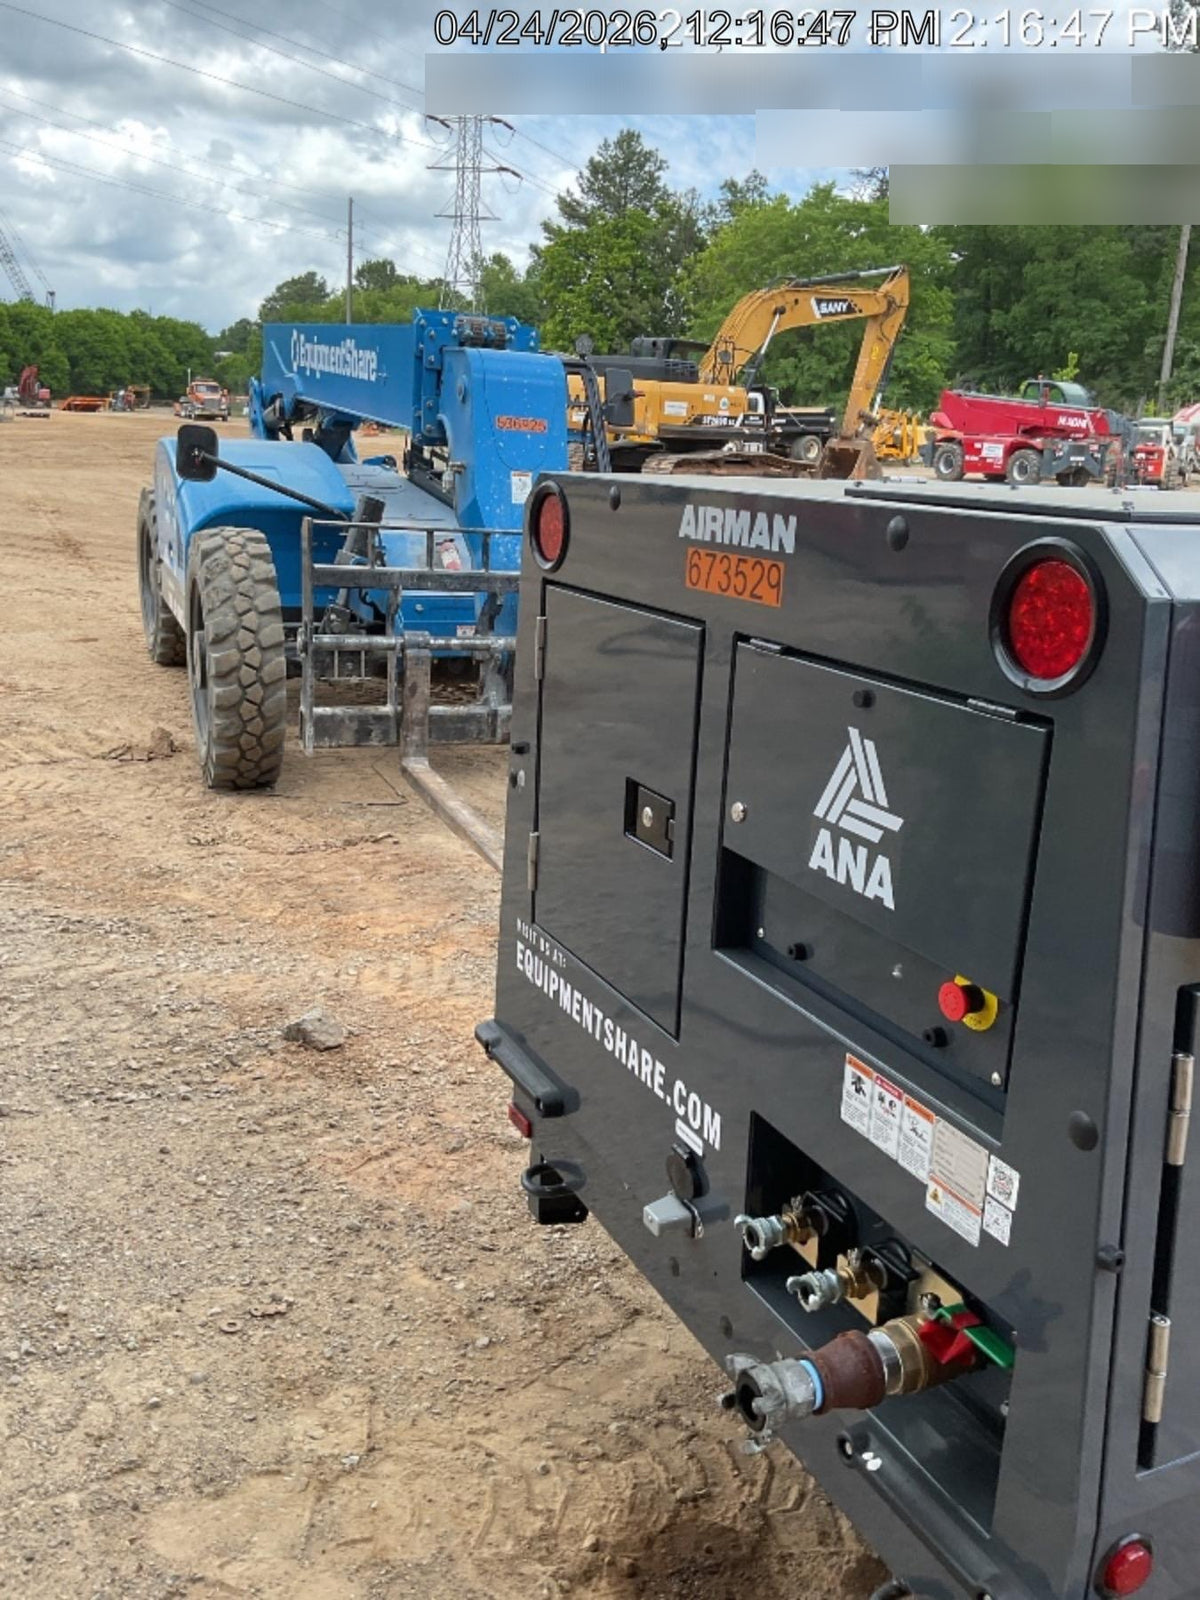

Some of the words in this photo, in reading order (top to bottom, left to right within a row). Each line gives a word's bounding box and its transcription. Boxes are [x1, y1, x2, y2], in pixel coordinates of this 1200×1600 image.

[820, 301, 849, 314] SANY
[299, 333, 378, 382] EquipmentShare
[678, 503, 798, 554] AIRMAN
[687, 549, 783, 604] 673529
[808, 827, 896, 911] ANA
[516, 940, 722, 1151] EQUIPMENTSHARE.COM
